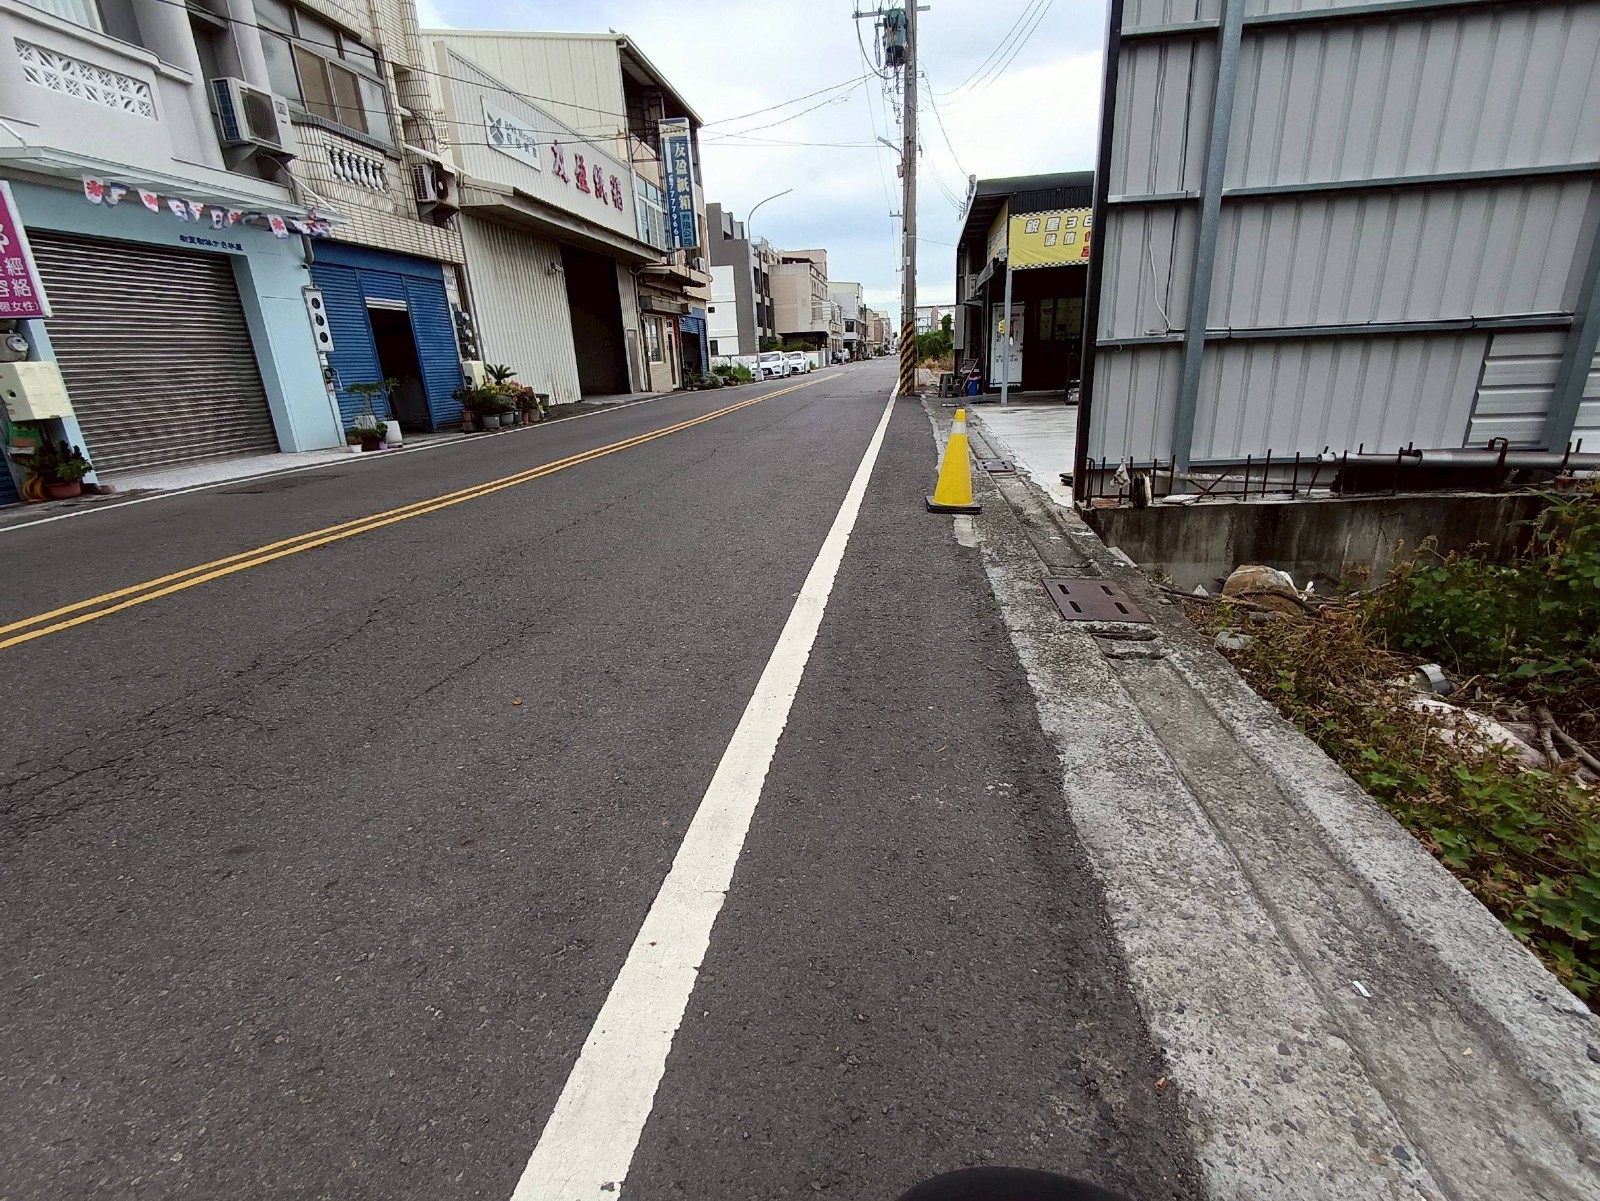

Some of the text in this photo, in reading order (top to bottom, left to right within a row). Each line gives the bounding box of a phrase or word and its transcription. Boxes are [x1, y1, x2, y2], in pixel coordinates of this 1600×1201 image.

[674, 142, 692, 210] 友盈紙箱
[681, 213, 694, 246] 有限公司
